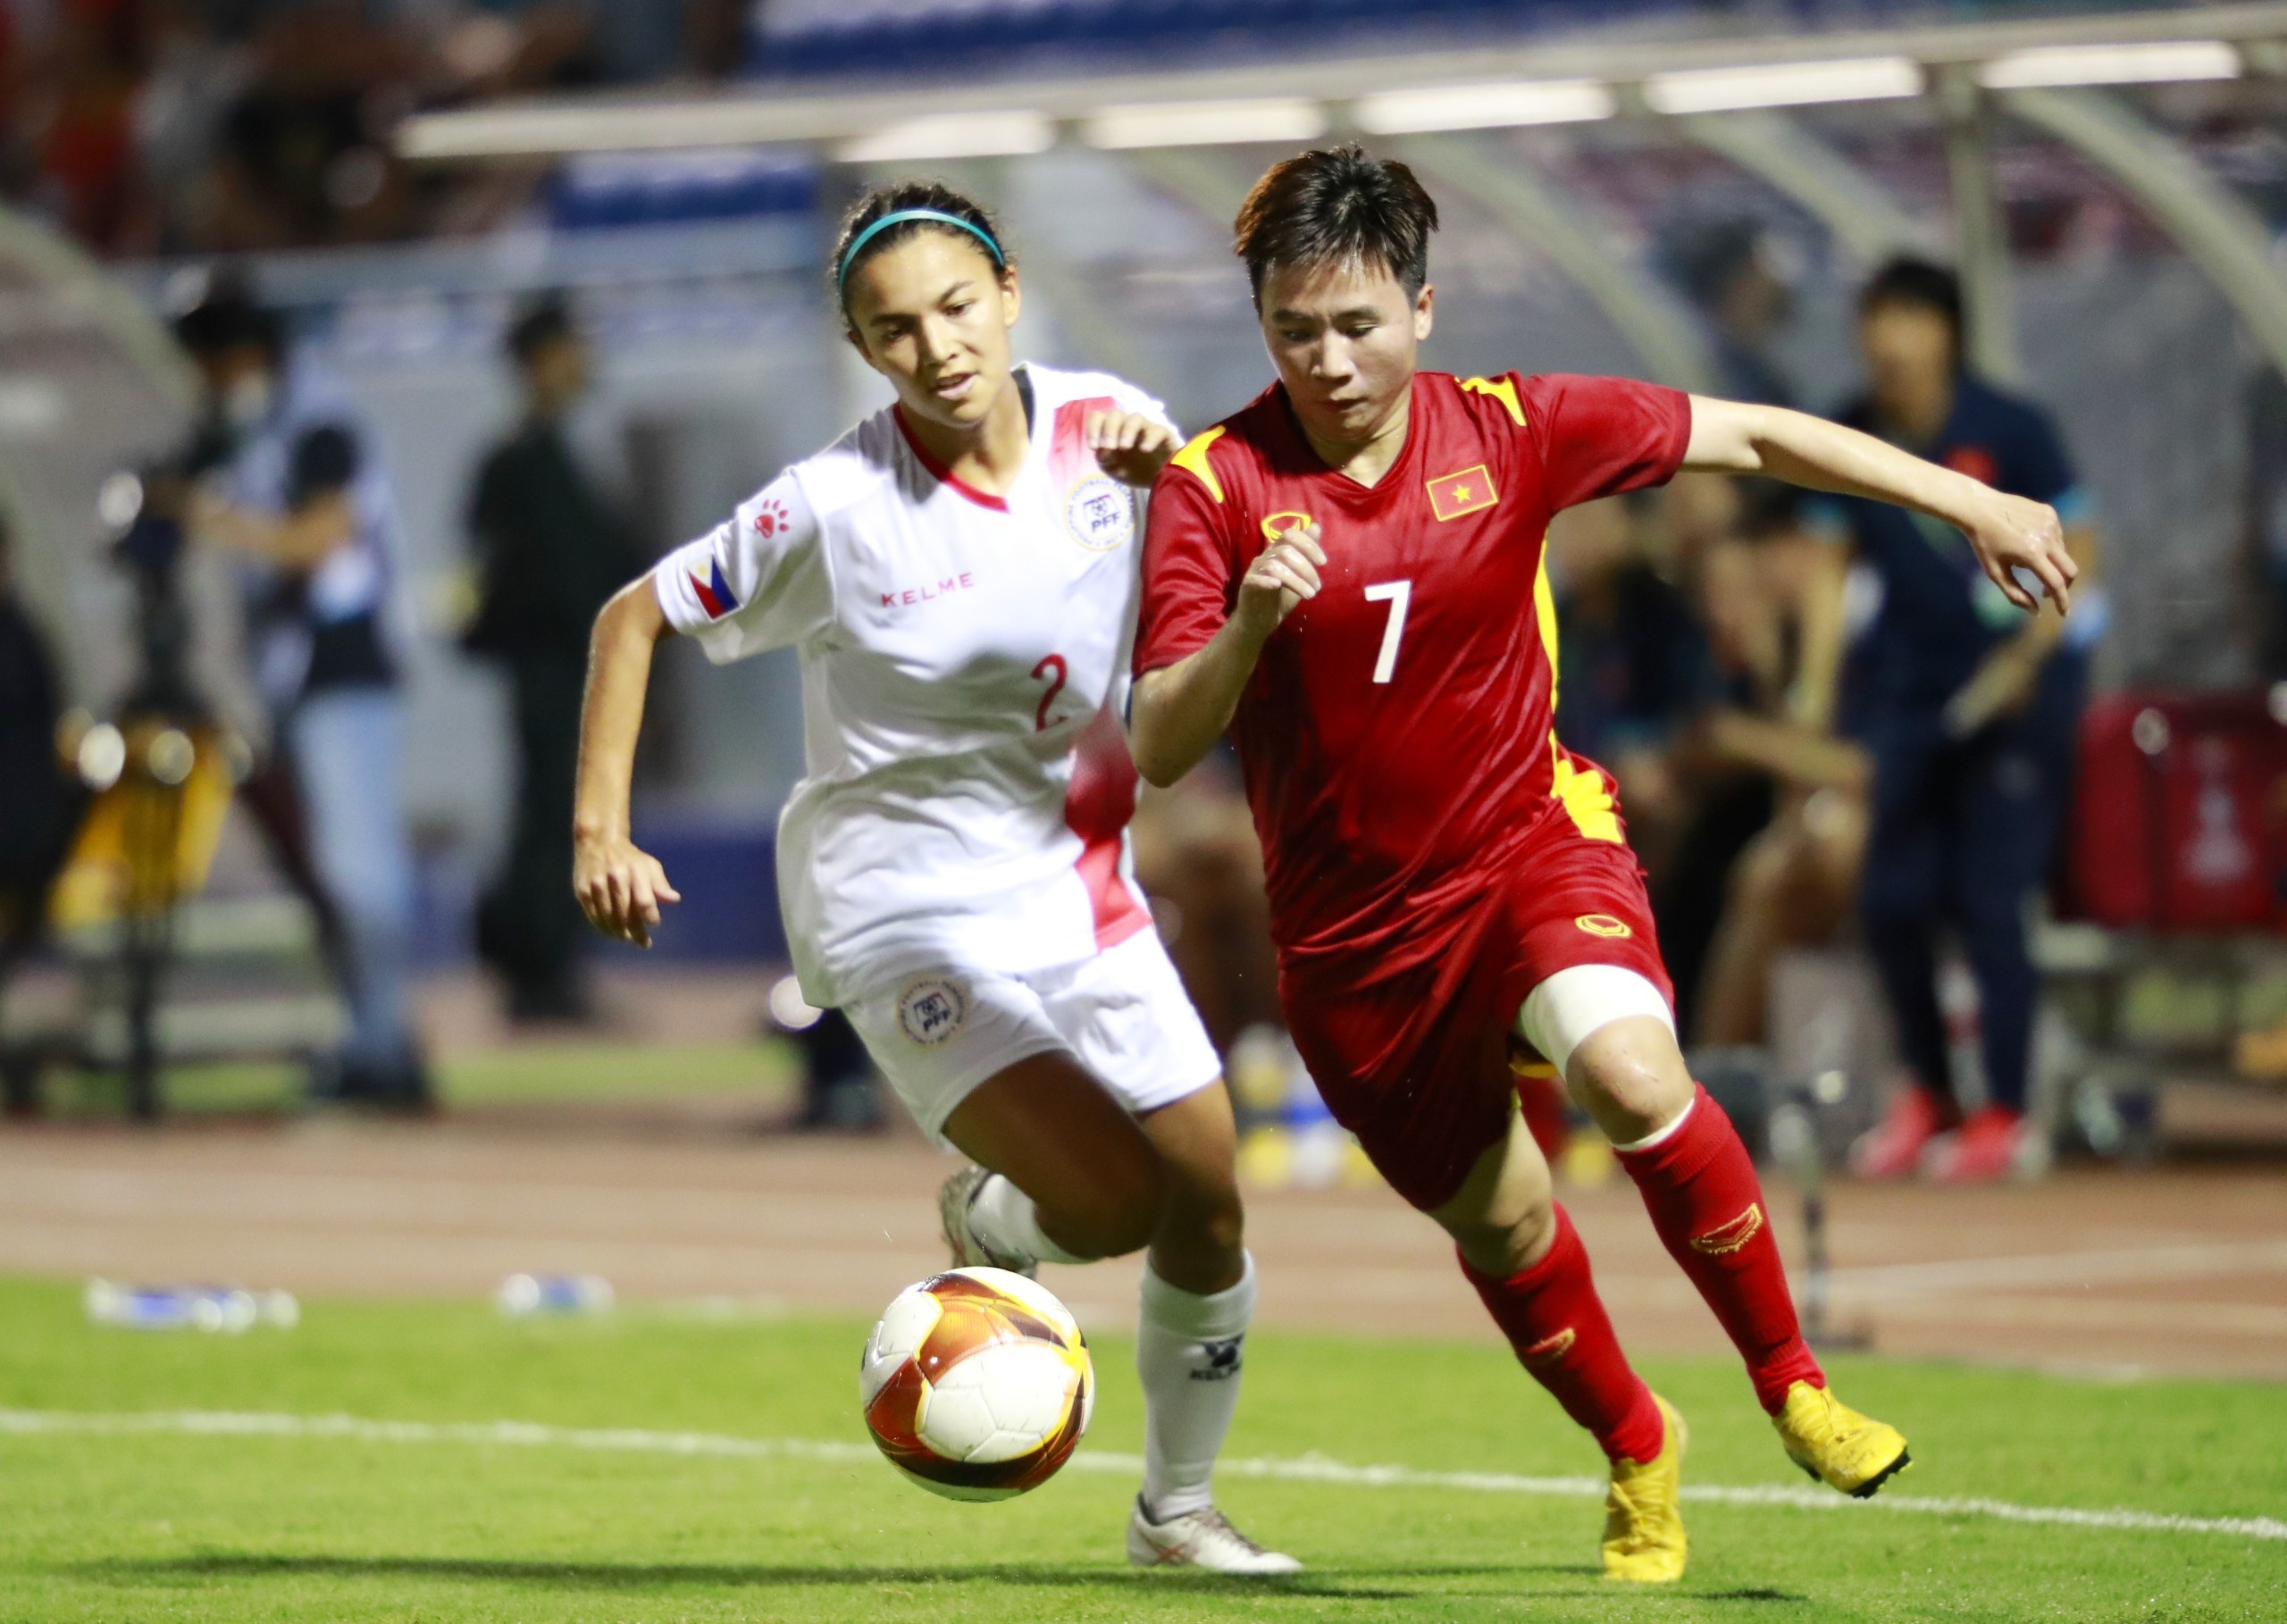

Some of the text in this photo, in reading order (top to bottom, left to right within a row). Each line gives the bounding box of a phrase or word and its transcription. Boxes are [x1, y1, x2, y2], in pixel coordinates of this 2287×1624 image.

[1091, 510, 1120, 533] PFF
[880, 571, 974, 607] KELME
[1363, 580, 1412, 683] 7
[1030, 653, 1068, 732] 2
